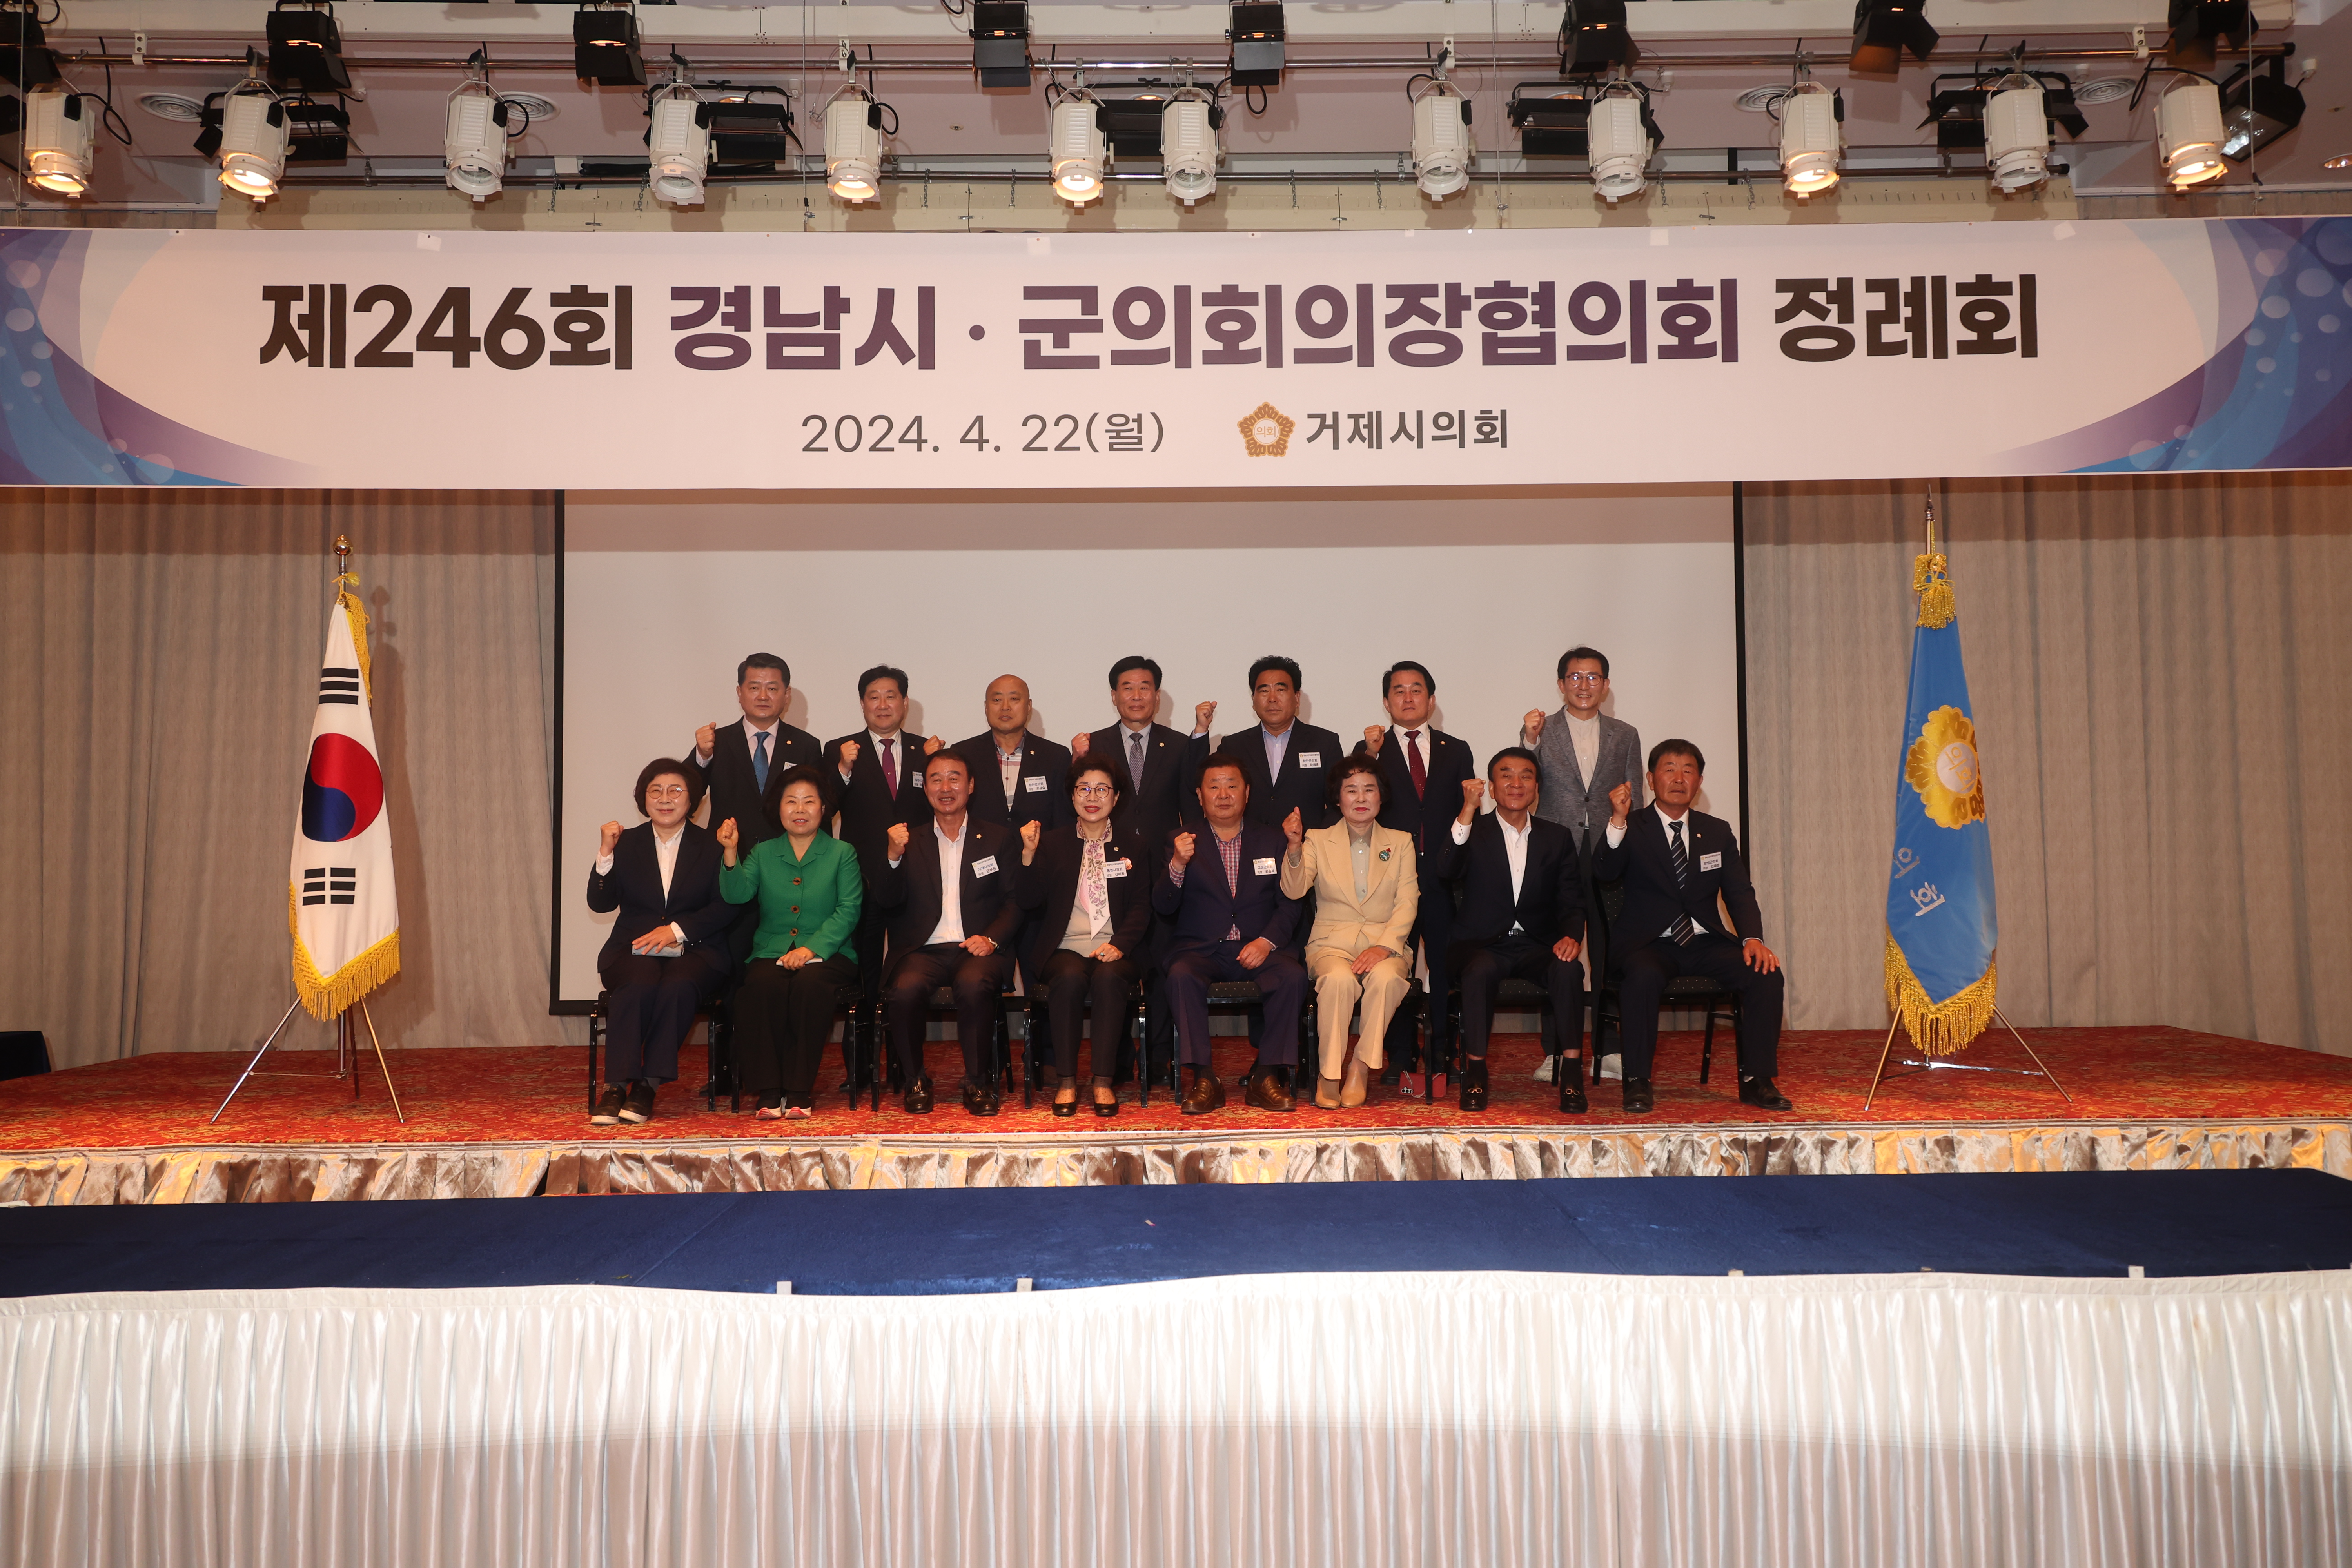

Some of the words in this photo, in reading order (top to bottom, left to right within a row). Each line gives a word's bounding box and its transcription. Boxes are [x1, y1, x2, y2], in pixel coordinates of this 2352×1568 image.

[260, 283, 632, 370] 제246회
[670, 285, 935, 371] 경남시
[1018, 278, 1739, 370] 군의회의장협의회
[1775, 274, 2038, 362] 정례회
[802, 414, 939, 453] 2024.
[960, 415, 1001, 452] 4.
[1022, 412, 1163, 453] 22(월)
[1256, 426, 1276, 437] 의회
[1306, 409, 1508, 450] 거제시의회
